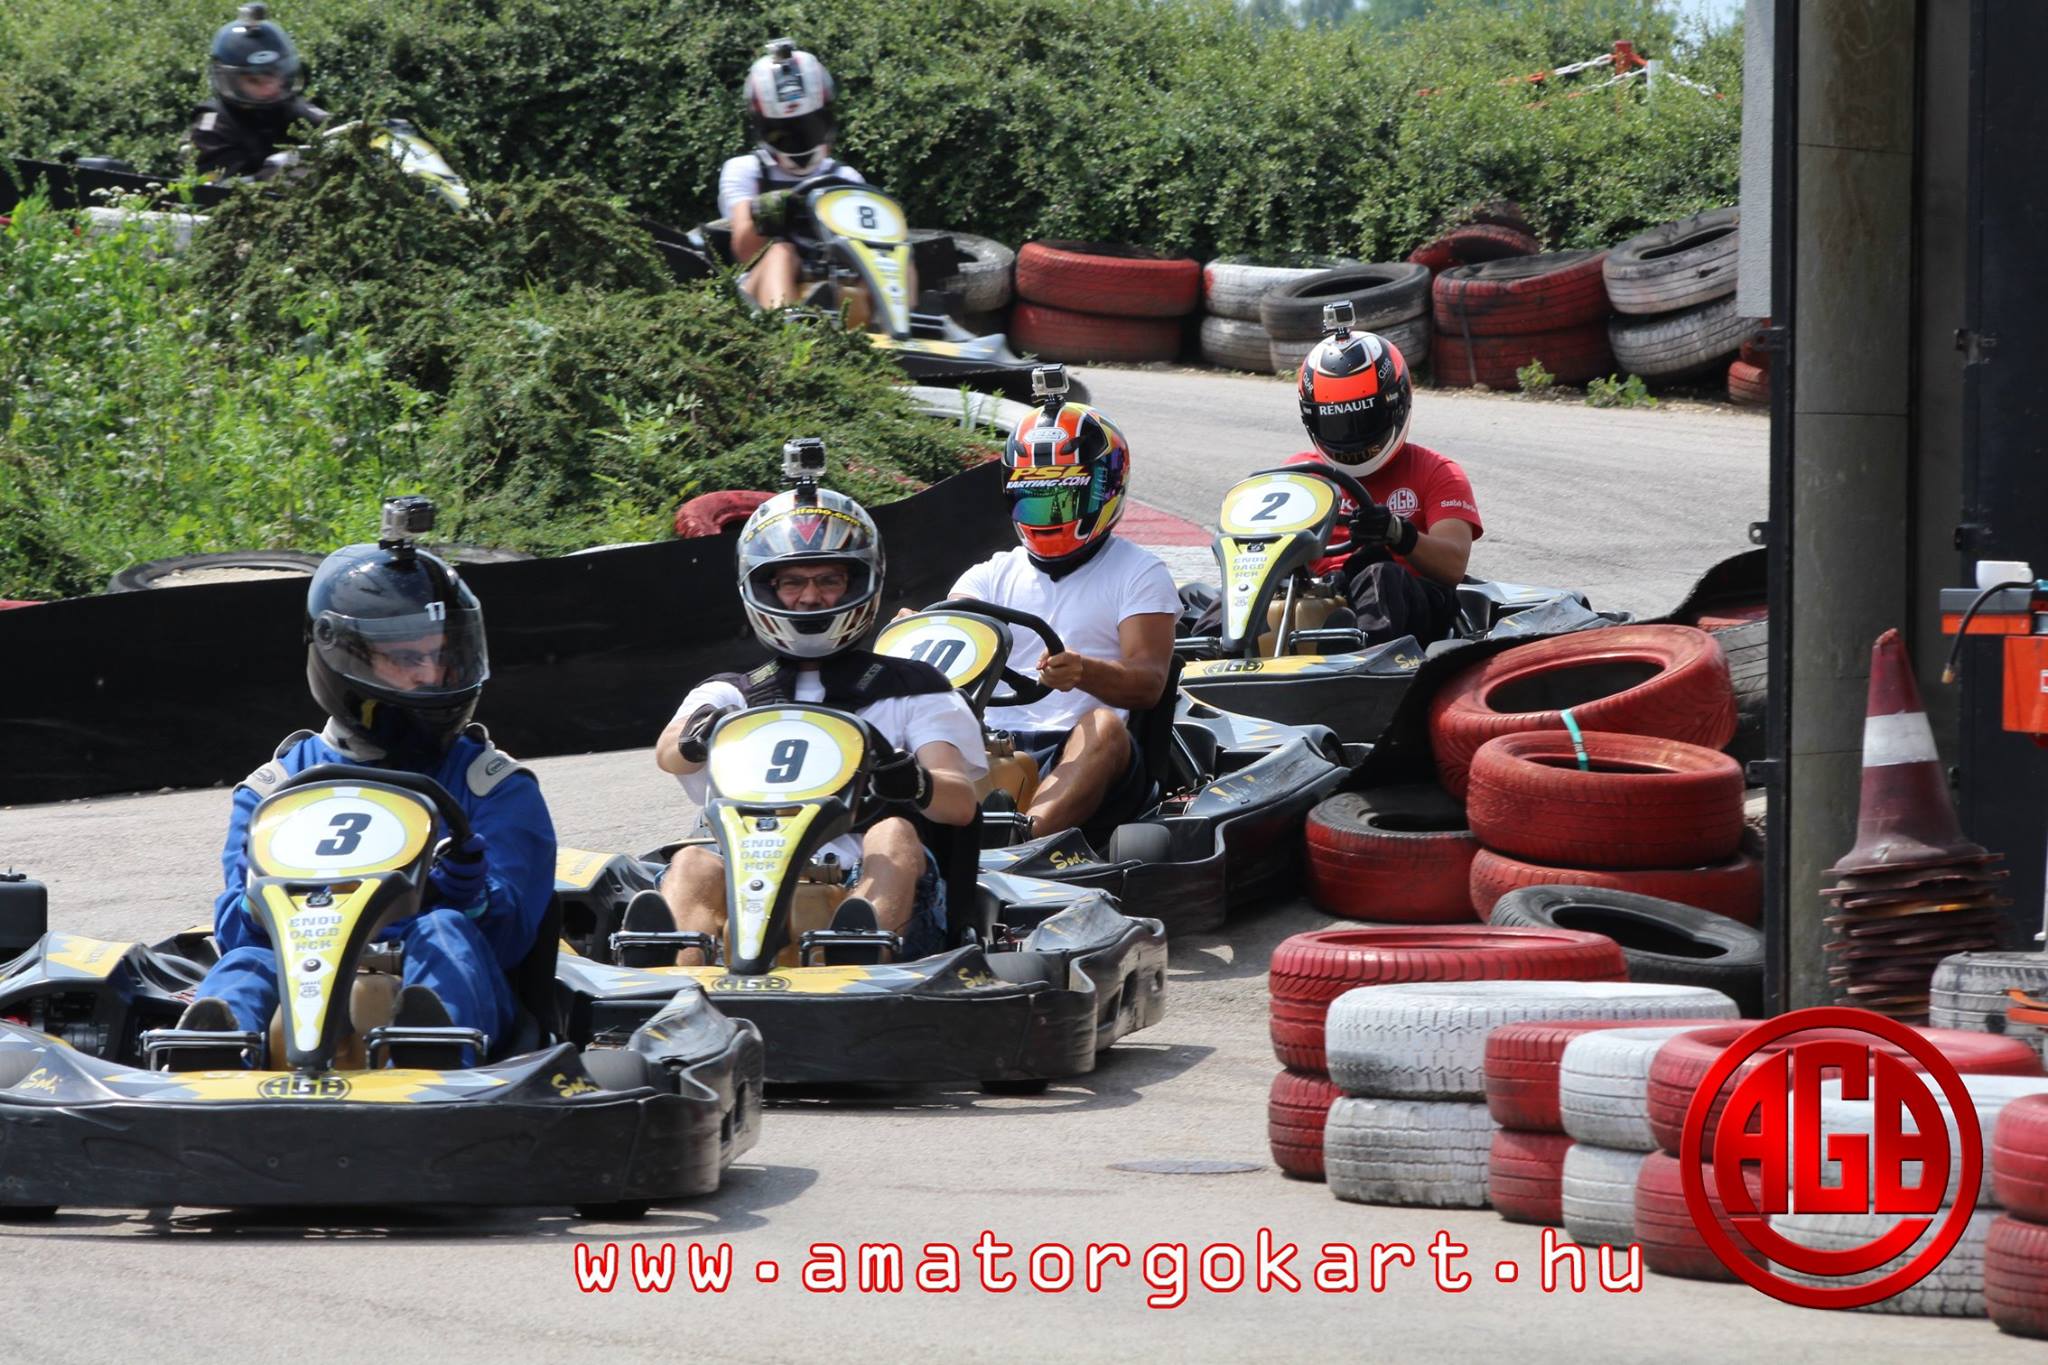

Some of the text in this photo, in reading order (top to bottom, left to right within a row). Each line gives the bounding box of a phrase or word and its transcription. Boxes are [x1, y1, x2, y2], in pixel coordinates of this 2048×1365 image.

[859, 206, 876, 229] 8
[1319, 397, 1376, 415] RENAULT
[1010, 466, 1088, 480] PSL
[1250, 492, 1291, 521] 2
[1388, 489, 1416, 511] AGB
[910, 639, 967, 674] 10
[765, 739, 809, 784] 9
[316, 813, 371, 856] 3
[261, 1076, 348, 1097] AGB
